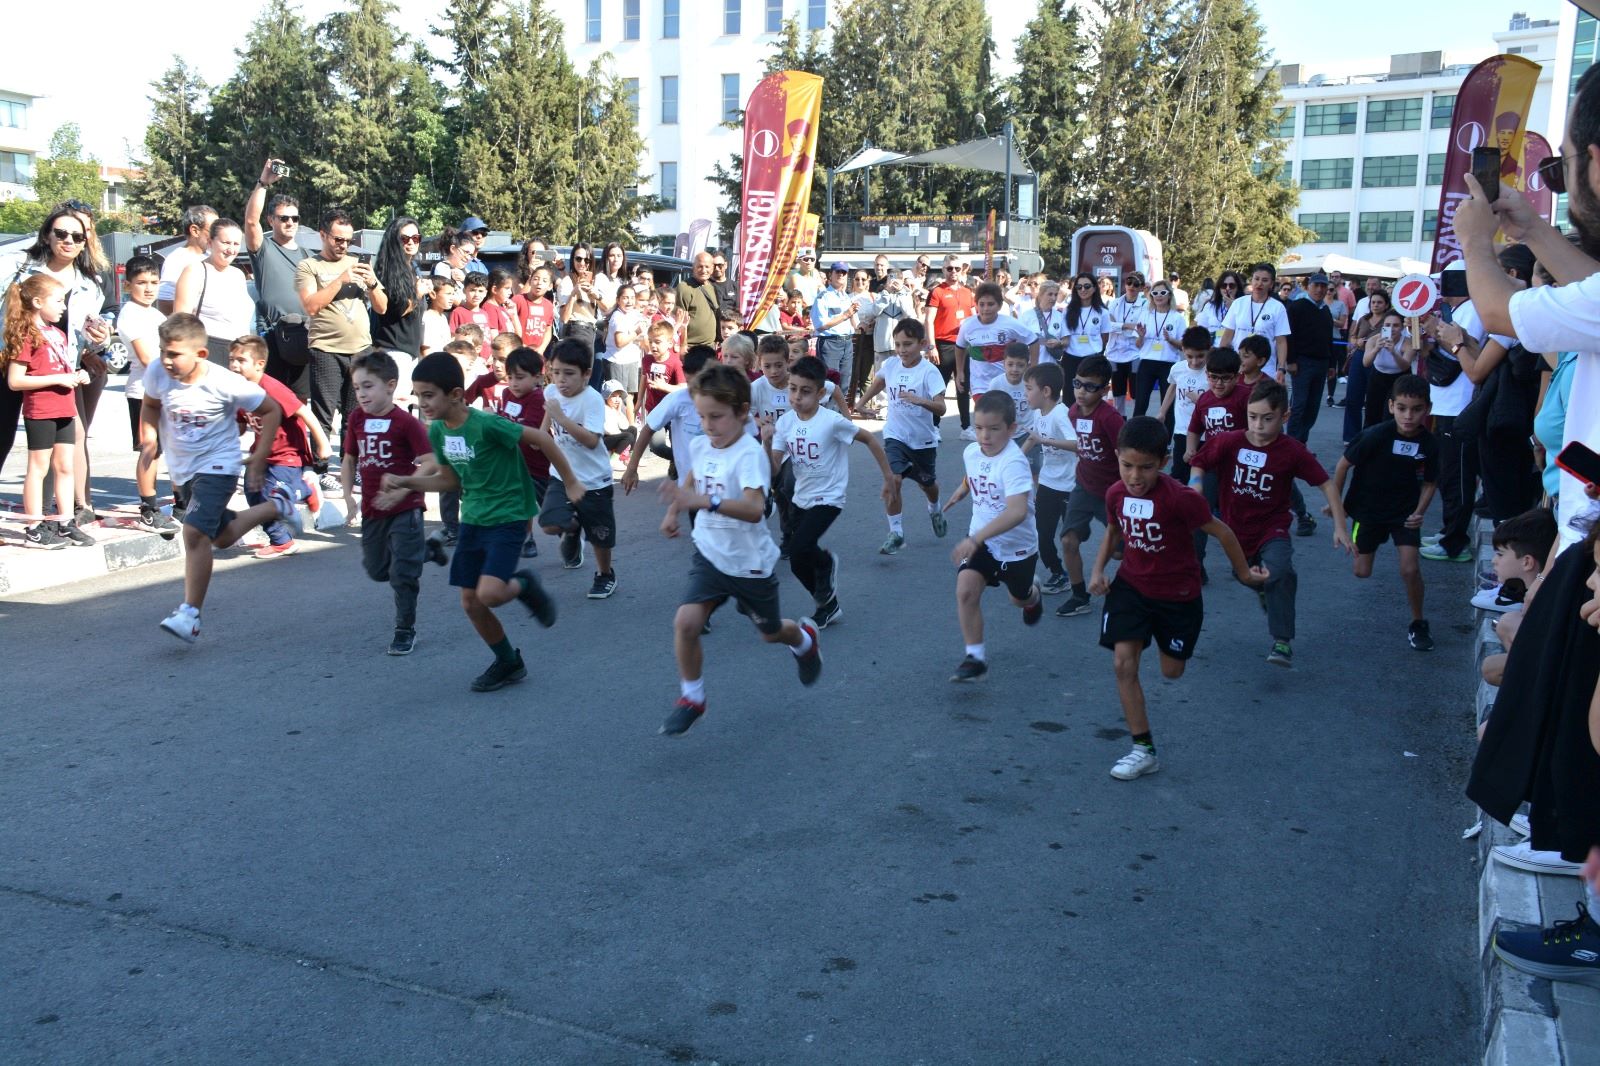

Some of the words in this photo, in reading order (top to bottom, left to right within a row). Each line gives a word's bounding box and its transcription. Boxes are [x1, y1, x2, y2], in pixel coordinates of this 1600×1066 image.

[746, 189, 776, 253] SAYGI
[1100, 246, 1117, 254] ATM
[526, 316, 546, 332] NEC
[776, 395, 786, 403] 71
[1205, 412, 1235, 430] NEC
[795, 427, 807, 436] 86
[786, 438, 820, 460] NEC
[1400, 443, 1412, 453] 79
[1245, 452, 1259, 464] 83
[1233, 464, 1274, 492] NEC
[969, 475, 1000, 501] NEC
[1129, 502, 1144, 514] 61
[1117, 516, 1163, 542] NEC
